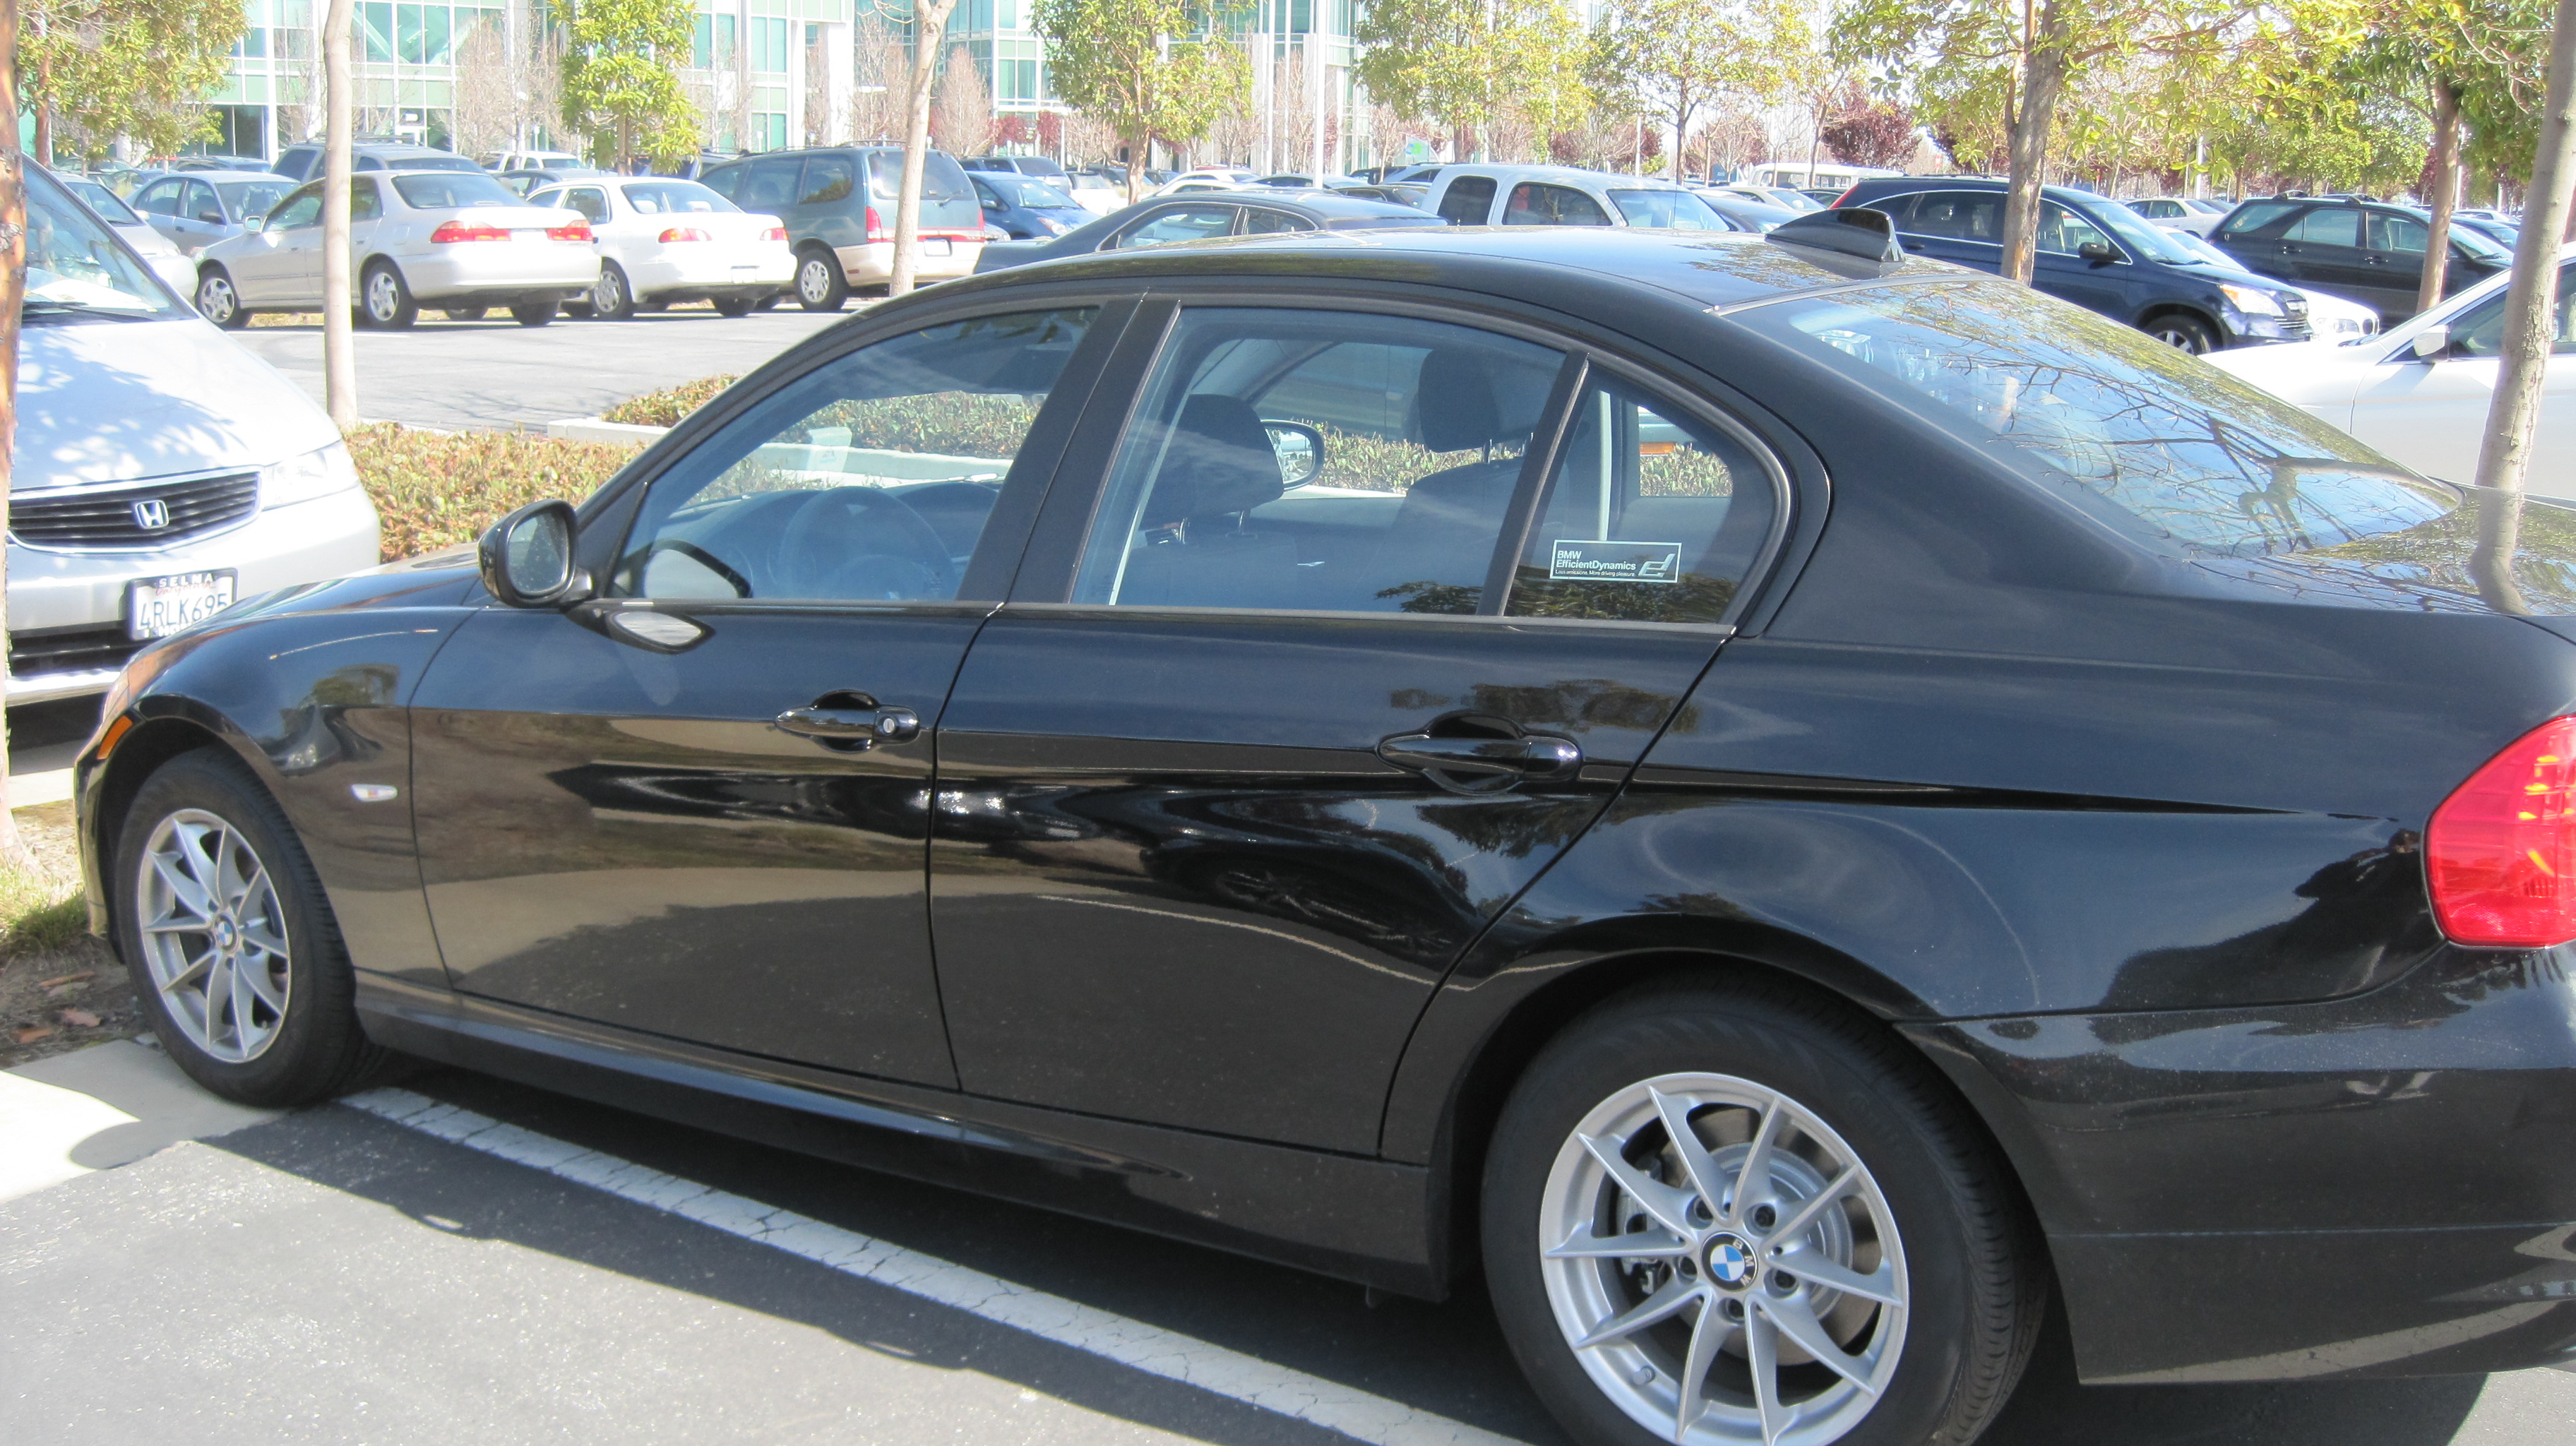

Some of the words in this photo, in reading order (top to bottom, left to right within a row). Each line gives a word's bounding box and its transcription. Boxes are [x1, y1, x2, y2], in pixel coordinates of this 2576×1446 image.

[1557, 550, 1582, 559] BMW
[1556, 559, 1636, 571] EfficientDynamics
[159, 573, 215, 588] SELMA
[140, 593, 228, 628] 4RLK695
[1733, 1238, 1755, 1287] BMW
